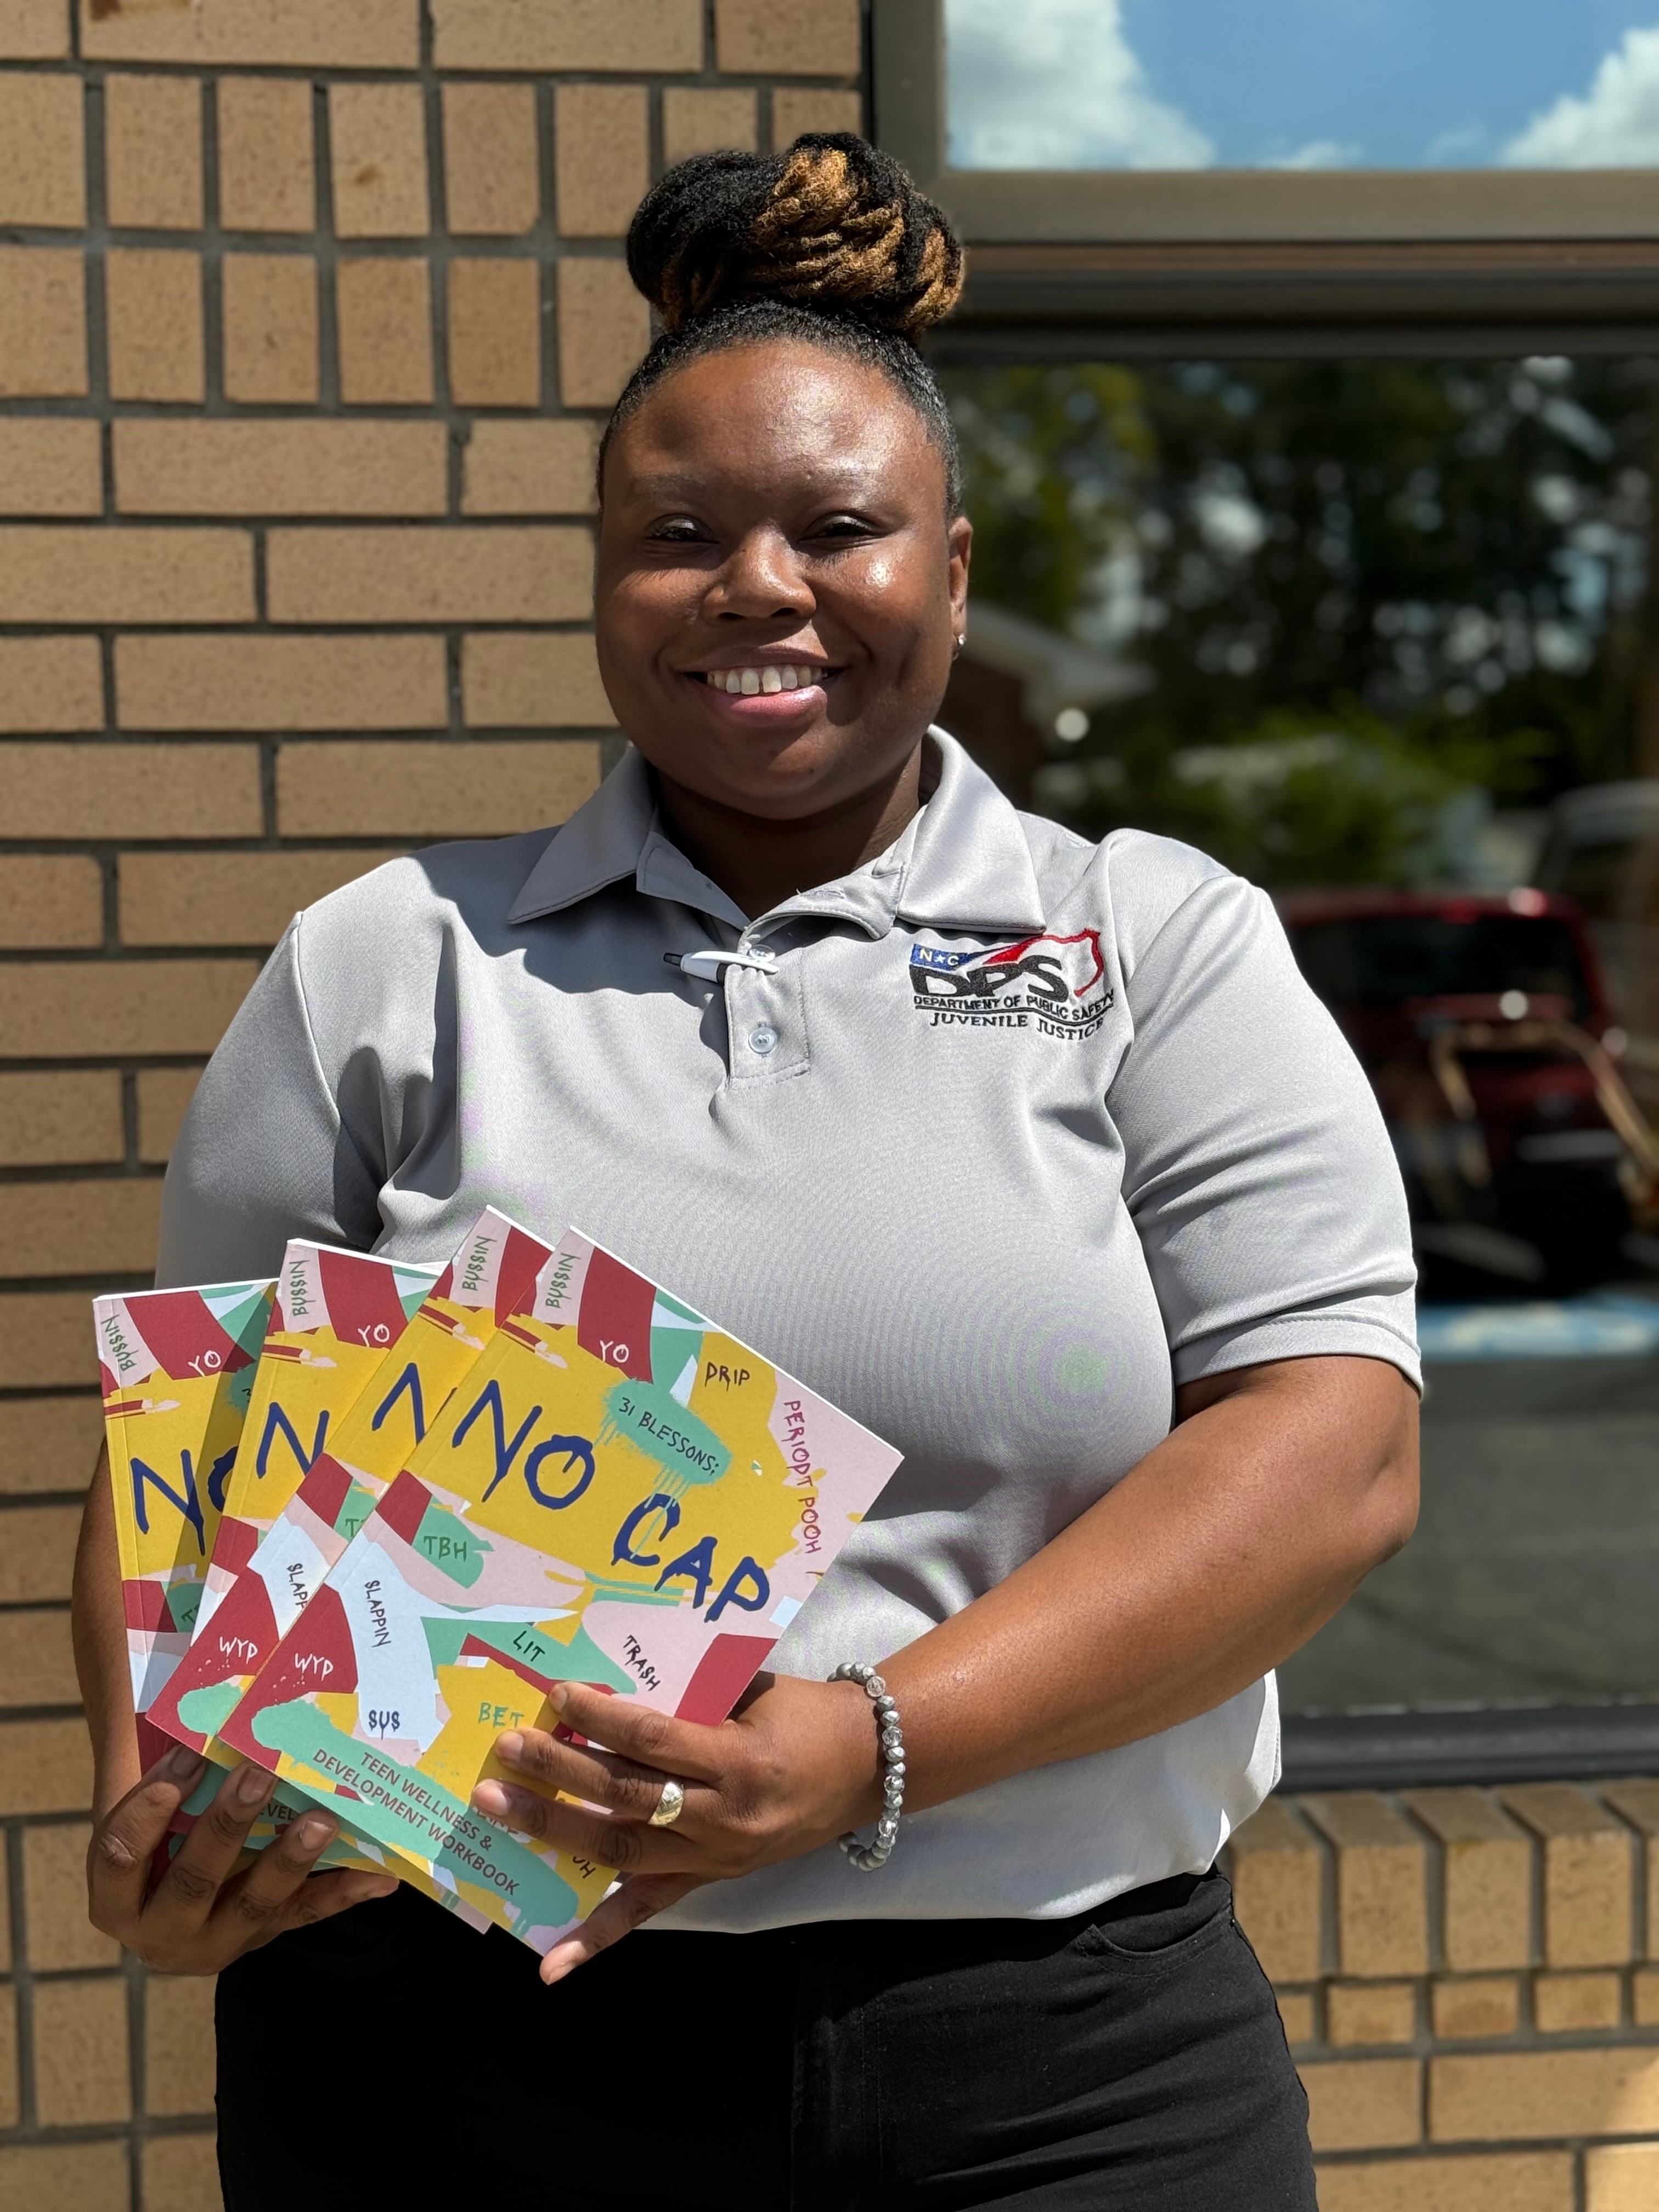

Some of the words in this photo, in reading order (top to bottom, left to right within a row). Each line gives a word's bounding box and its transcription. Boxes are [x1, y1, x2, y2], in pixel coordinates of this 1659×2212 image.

[919, 948, 933, 961] N
[947, 955, 960, 966] C
[909, 955, 1069, 1003] DPS
[913, 995, 1000, 1009] DEPARTMENT
[1003, 995, 1021, 1008] OF
[1026, 995, 1069, 1020] PUBLIC
[1071, 989, 1115, 1020] SAFETY
[930, 1013, 1028, 1028] JUVENILE
[1036, 1017, 1104, 1041] JUSTICE
[462, 1235, 498, 1291] BUSSIN
[291, 1260, 310, 1317] BUSSIN
[545, 1252, 581, 1309] BUSSIN
[101, 1314, 136, 1372] BUSSIN
[358, 1323, 391, 1346] YO
[188, 1350, 222, 1377] YO
[599, 1339, 630, 1363] YO
[703, 1361, 751, 1392] DRIP
[618, 1397, 635, 1417] 31
[783, 1400, 814, 1489] PERIODT
[451, 1379, 596, 1510] NO
[611, 1493, 770, 1623] CAP
[798, 1496, 822, 1554] POOH
[423, 1535, 468, 1562] TBH
[364, 1579, 392, 1649] SLAPPIN
[219, 1637, 258, 1663] WYD
[512, 1630, 546, 1662] LIT
[295, 1653, 334, 1680] WYD
[623, 1635, 661, 1692] TRASH
[368, 1709, 401, 1740] SUS
[478, 1702, 525, 1729] BET
[360, 1752, 401, 1786] TEEN
[401, 1778, 481, 1841] WELLNESS
[479, 1835, 493, 1852] &
[312, 1748, 428, 1830] DEVELOPMENT
[427, 1822, 521, 1896] WORKBOOK
